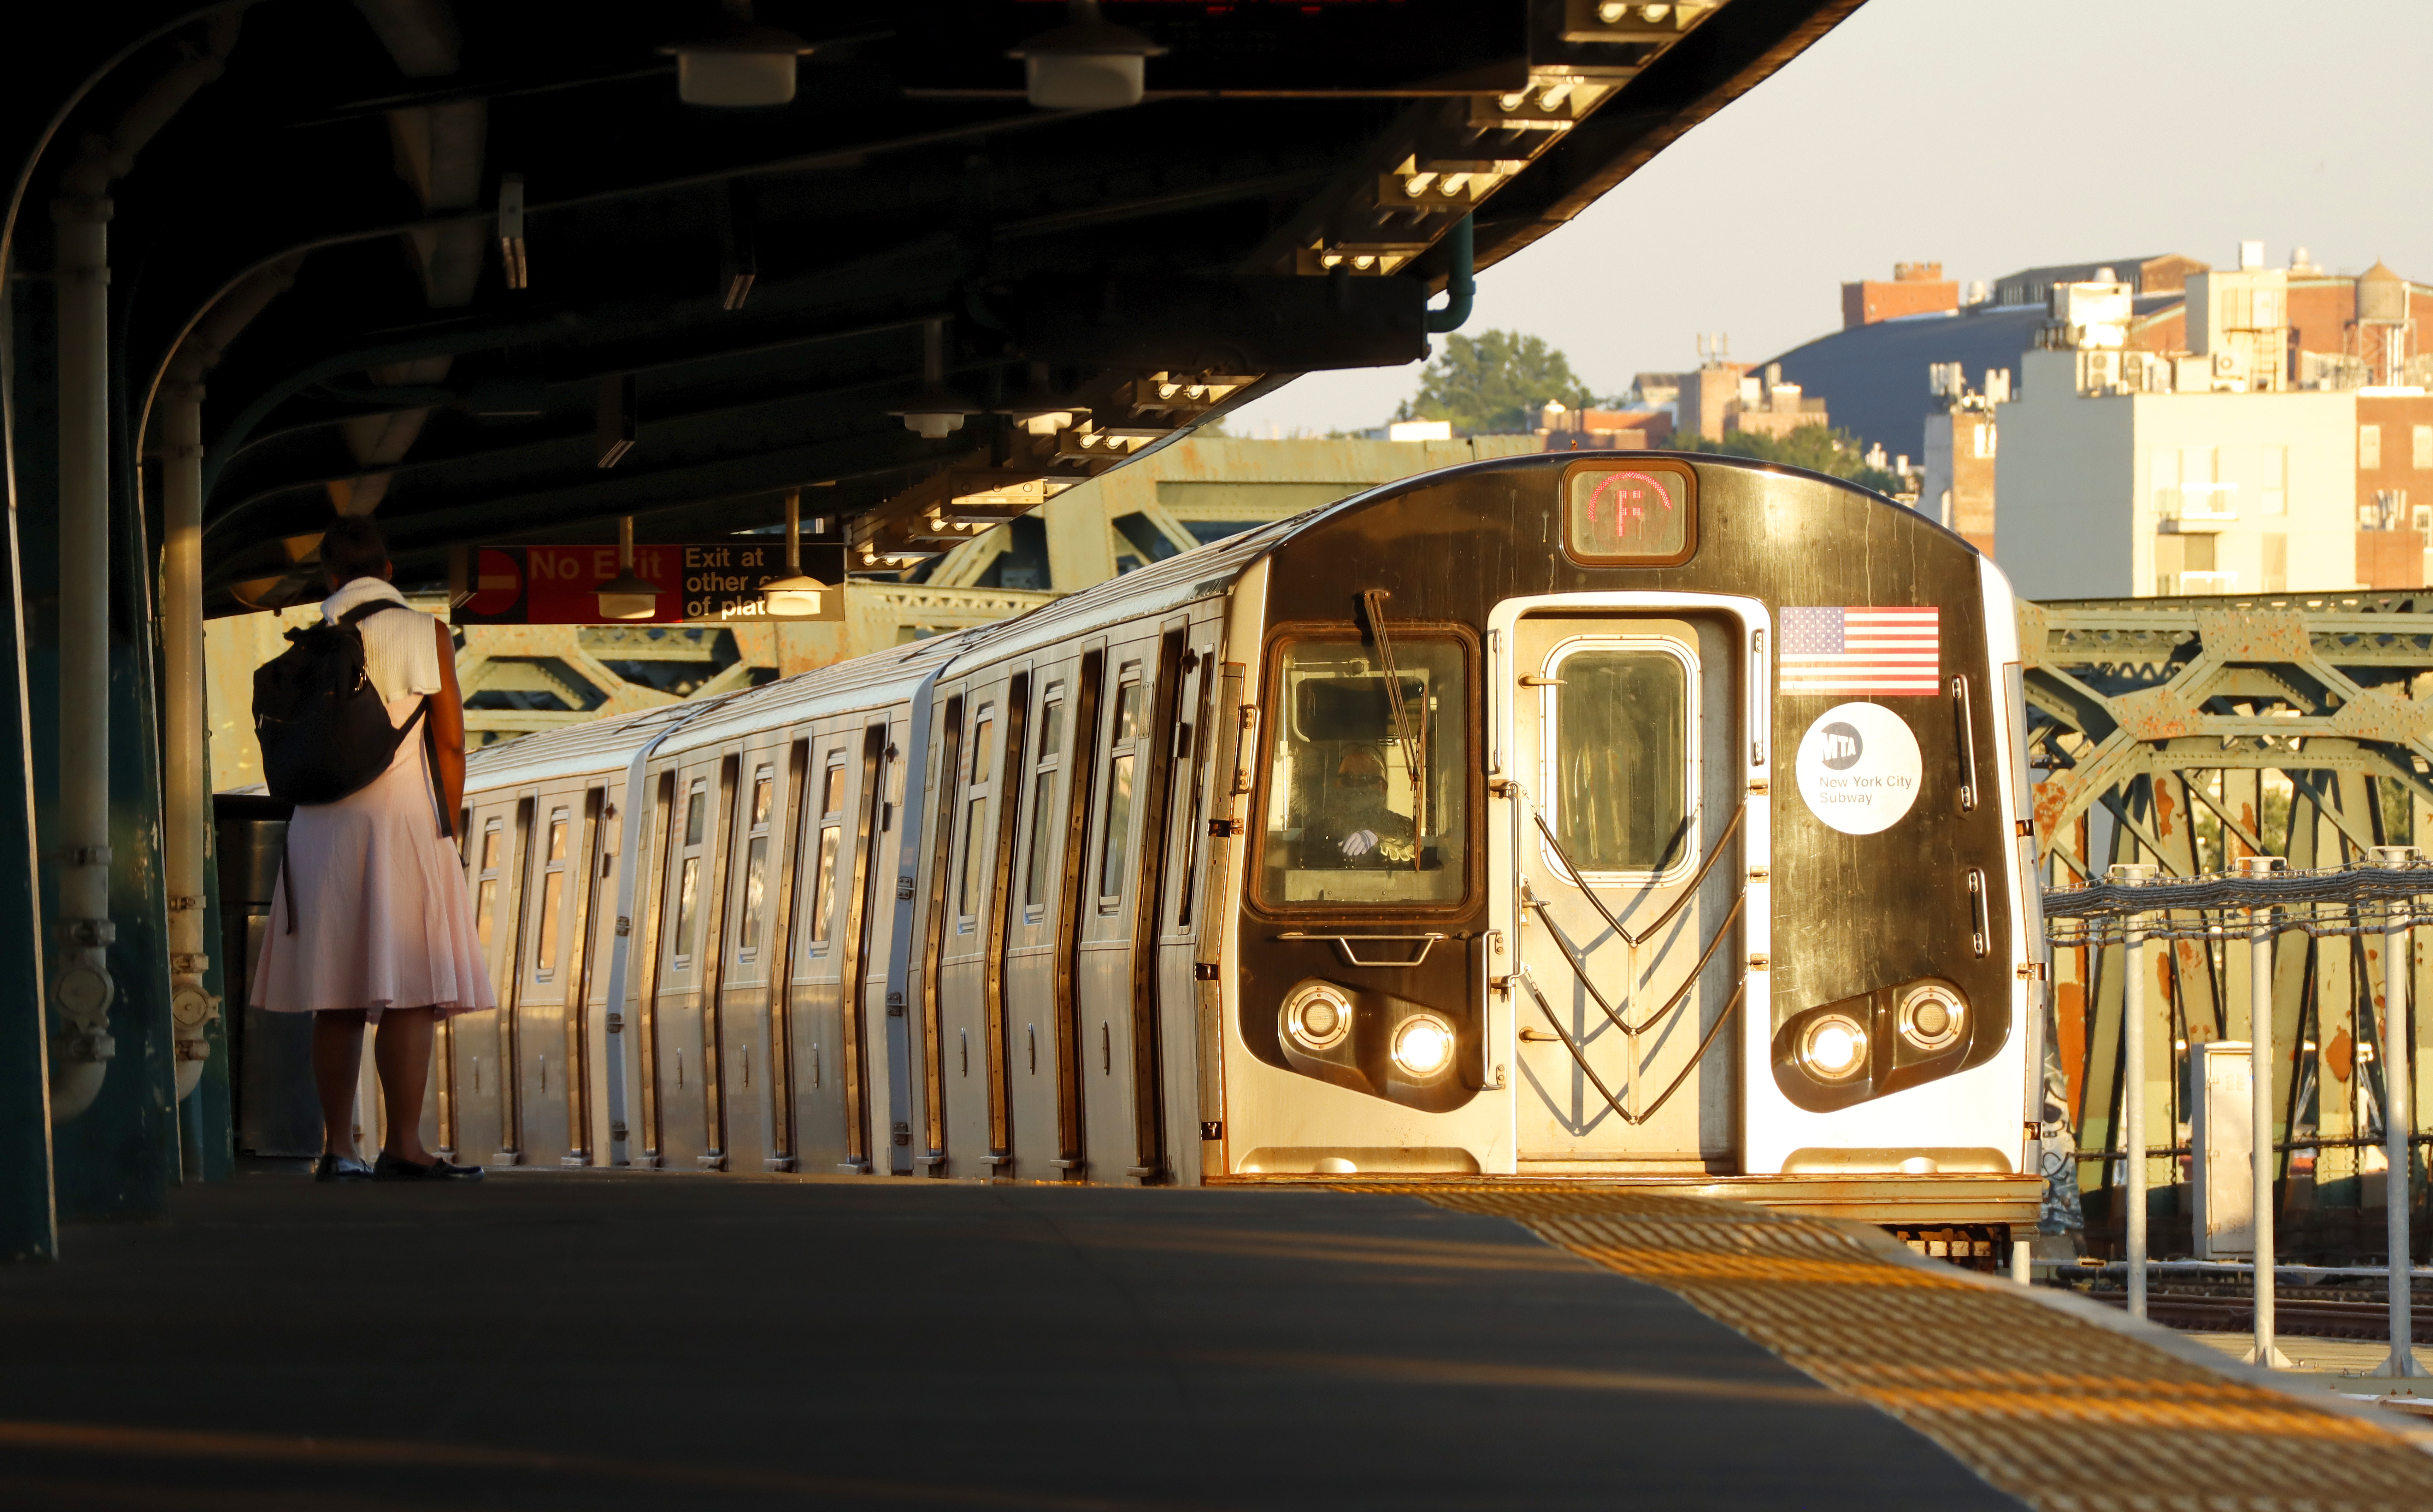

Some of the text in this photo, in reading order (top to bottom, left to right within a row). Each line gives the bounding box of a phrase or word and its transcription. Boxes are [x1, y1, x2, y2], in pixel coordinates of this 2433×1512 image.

[531, 549, 662, 579] No Eit
[686, 547, 764, 567] Exit at
[687, 571, 748, 592] other
[687, 595, 766, 620] of plat
[1820, 731, 1856, 760] MTA
[1820, 776, 1912, 789] New York City
[1820, 792, 1872, 805] Subway
